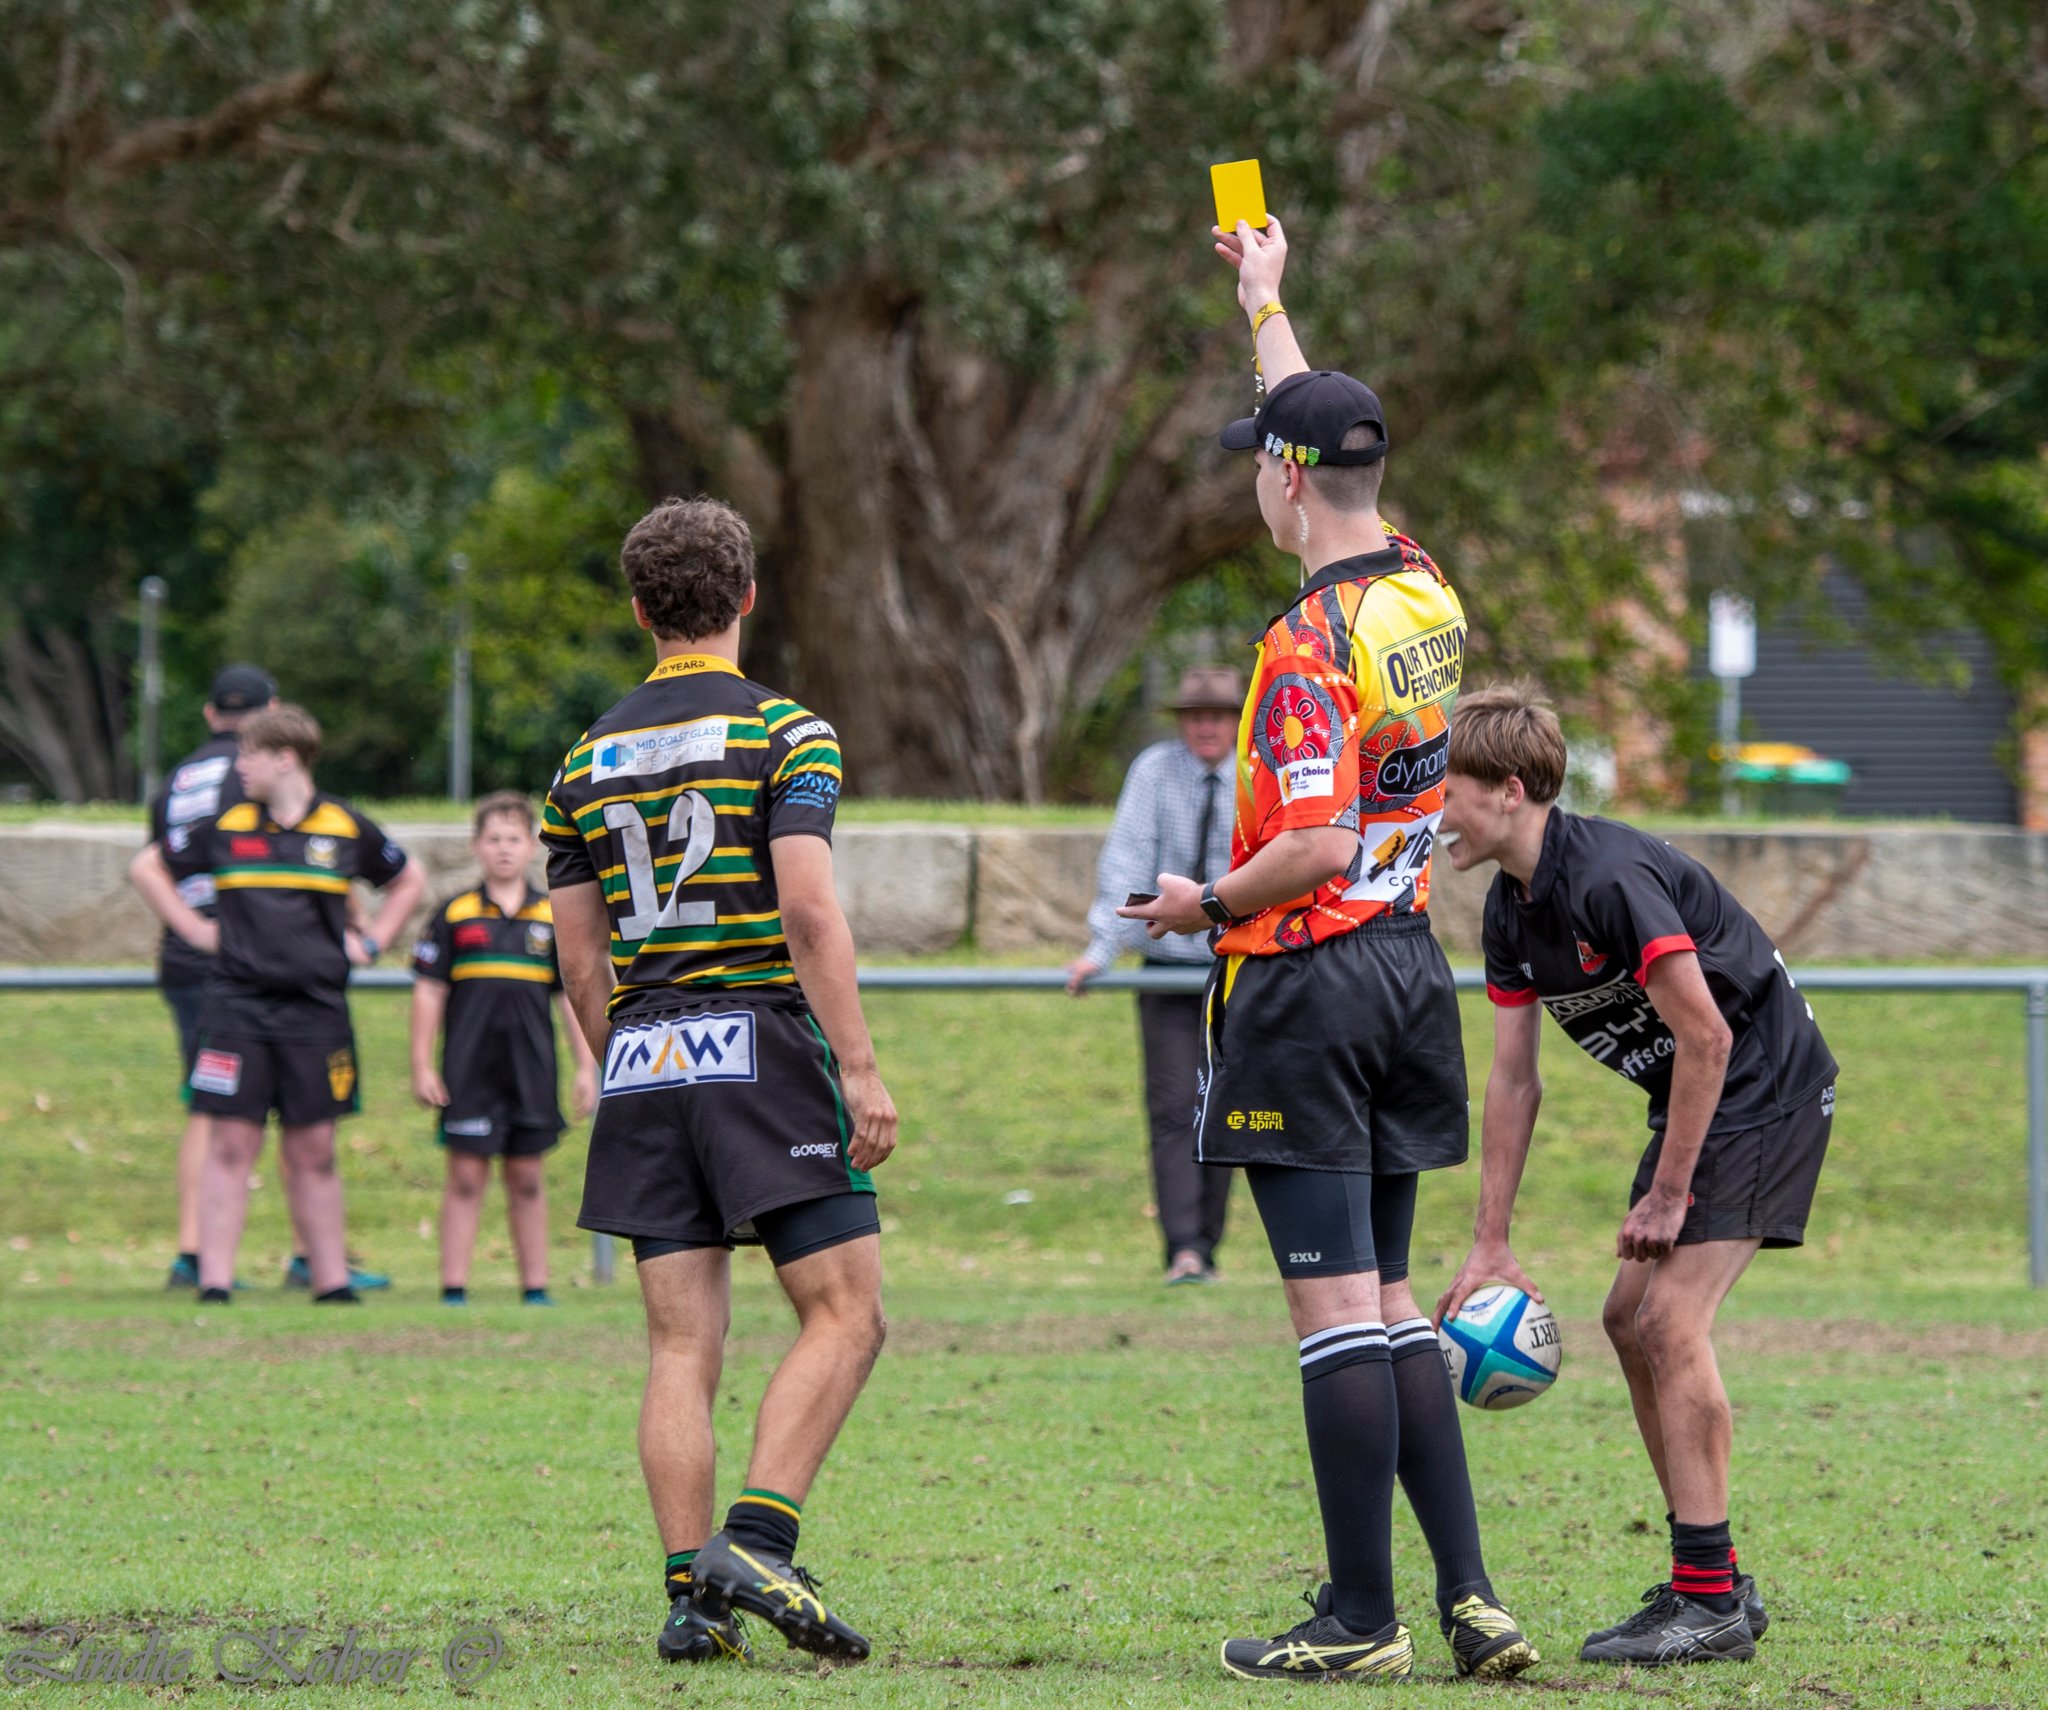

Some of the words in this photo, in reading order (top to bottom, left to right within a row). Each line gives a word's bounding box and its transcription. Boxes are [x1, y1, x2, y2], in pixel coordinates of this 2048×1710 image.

[669, 660, 706, 673] YEARS
[1387, 645, 1423, 698] OUR
[1419, 626, 1467, 668] TOWN
[1411, 659, 1461, 703] FENCING
[636, 739, 657, 751] MID
[658, 731, 689, 747] COAST
[690, 726, 723, 739] GLASS
[1301, 766, 1330, 777] Choice
[602, 788, 717, 942] 12
[790, 1142, 839, 1157] GOOSEY
[1289, 1252, 1322, 1263] 2XU
